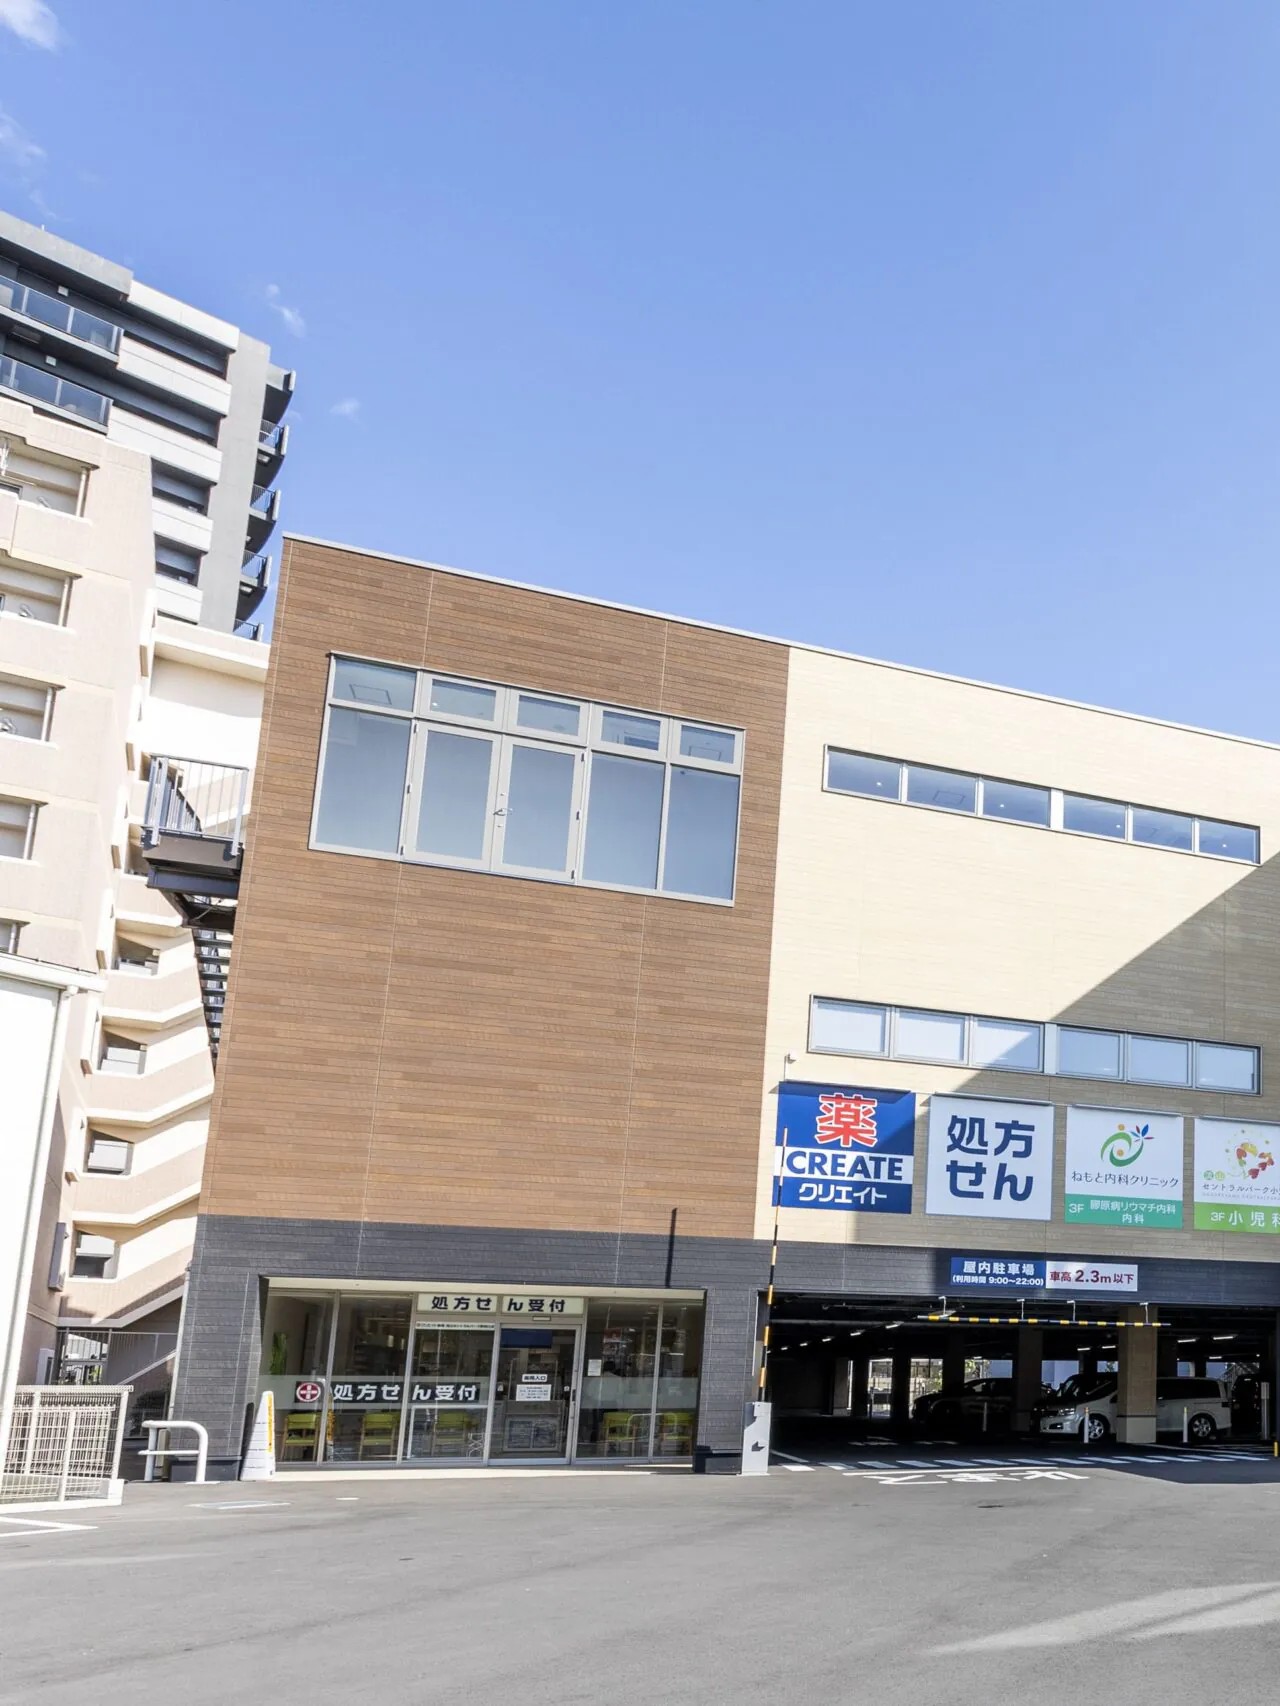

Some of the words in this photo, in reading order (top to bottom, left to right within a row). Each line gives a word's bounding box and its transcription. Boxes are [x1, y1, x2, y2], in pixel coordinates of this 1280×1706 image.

[815, 1092, 878, 1148] 薬
[946, 1115, 1035, 1159] 処方
[786, 1151, 903, 1181] CREATE
[946, 1160, 1034, 1201] せん
[1071, 1170, 1179, 1187] ねもと内科クリニック
[799, 1182, 887, 1205] クリエイト
[1068, 1203, 1085, 1214] 3F
[1210, 1211, 1225, 1222] 3F
[1121, 1213, 1145, 1224] 内科
[963, 1260, 1035, 1276] 屋内駐車場
[431, 1295, 566, 1312] 処方せん受付
[333, 1384, 477, 1401] 処方せん受付
